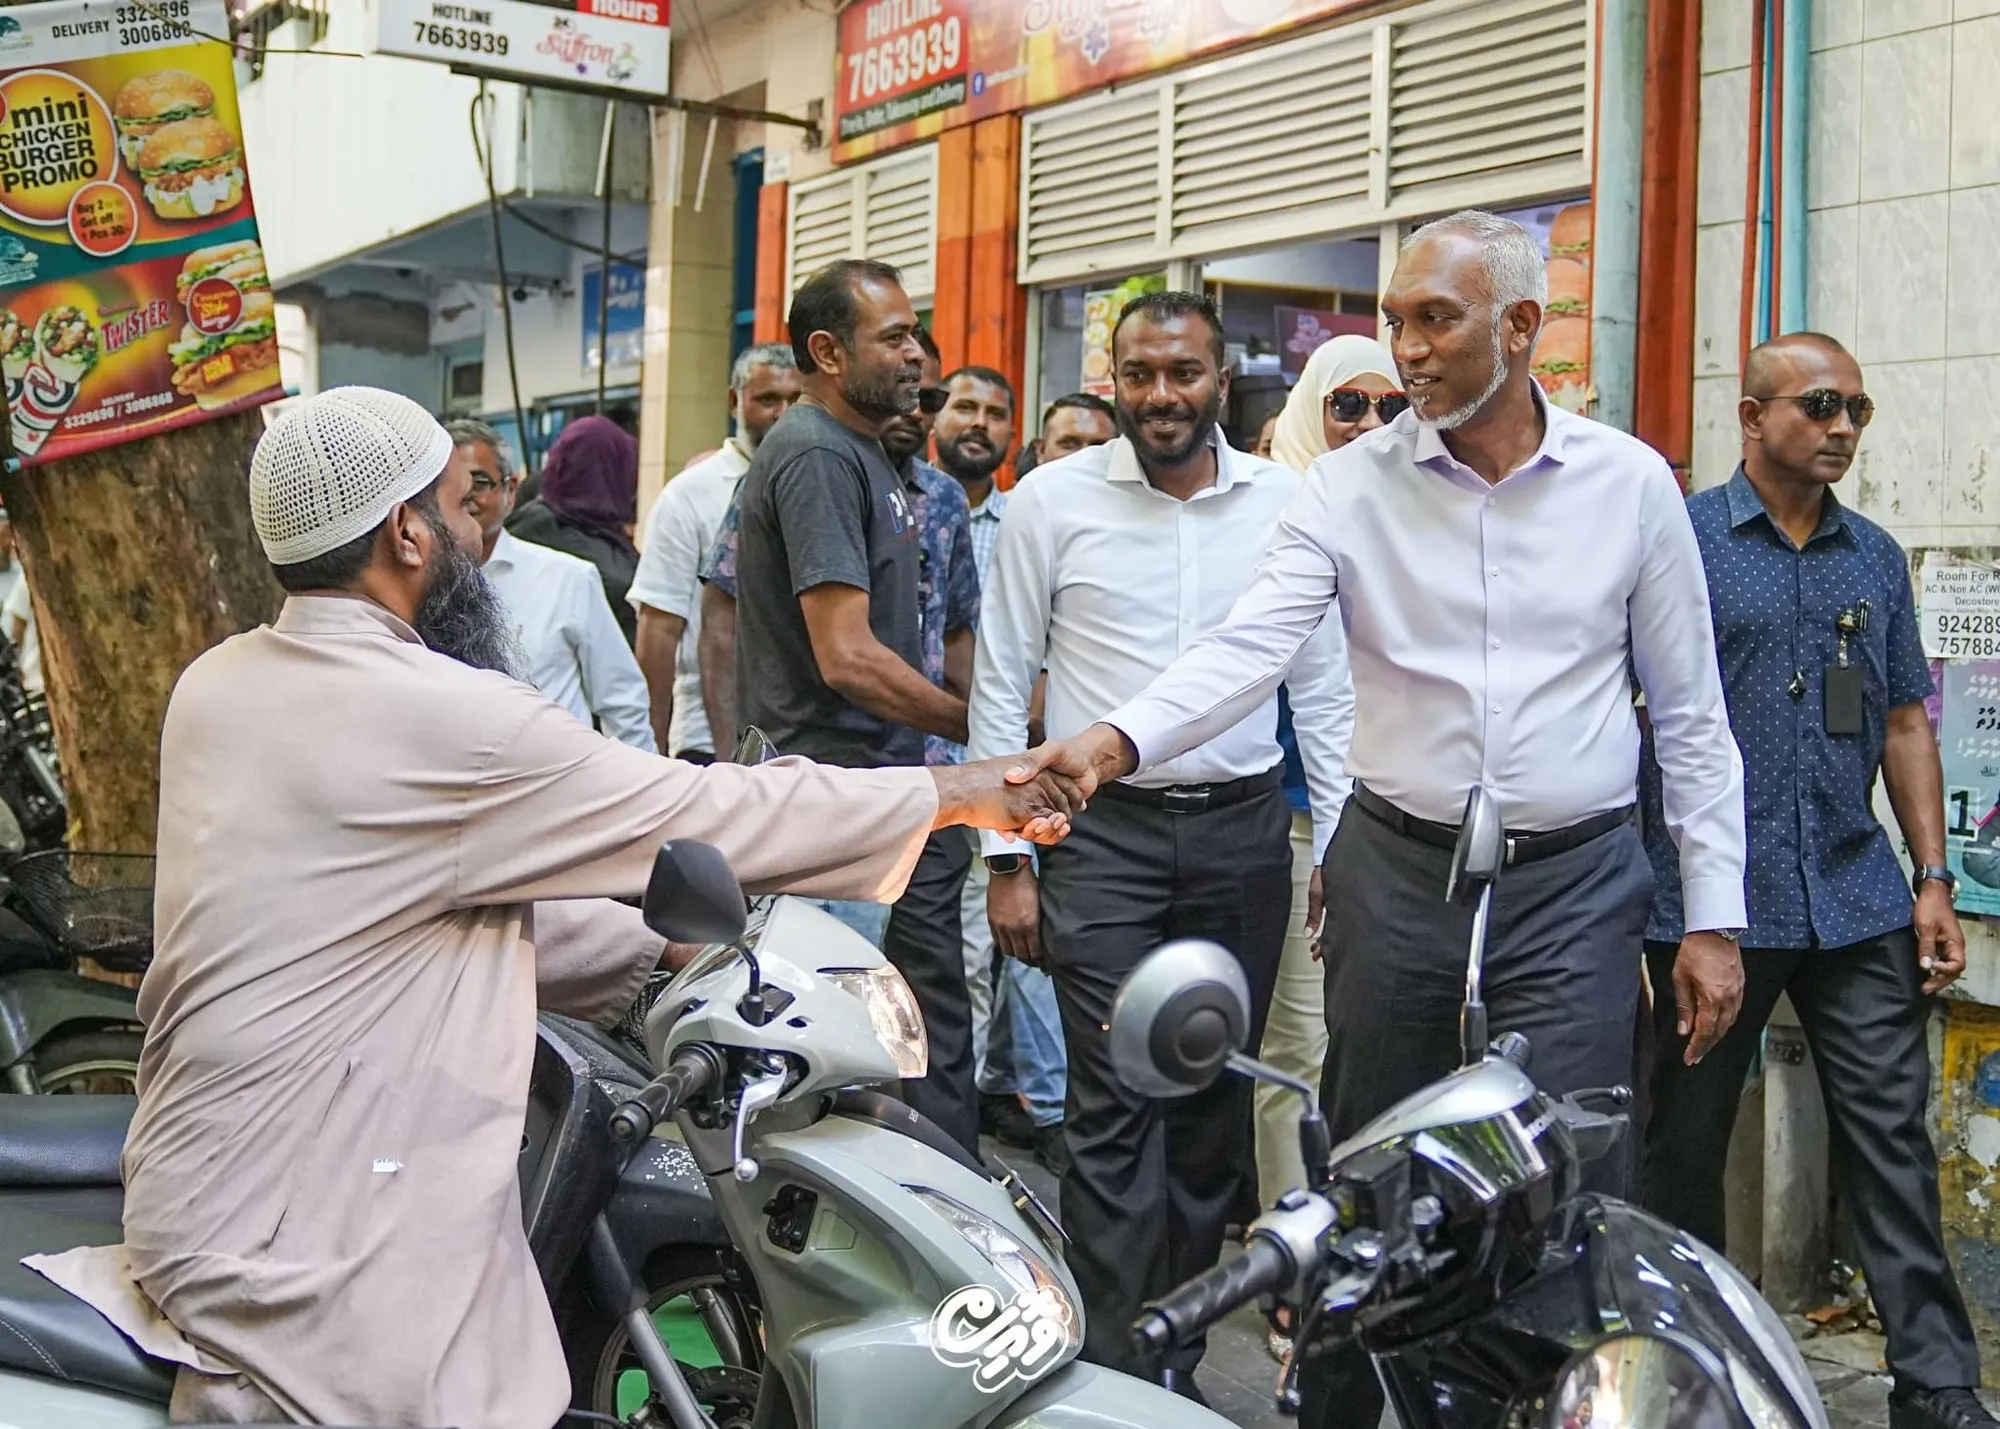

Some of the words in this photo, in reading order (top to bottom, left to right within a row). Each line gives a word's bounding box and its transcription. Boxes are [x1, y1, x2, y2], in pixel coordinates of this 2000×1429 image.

[52, 20, 110, 38] DELIVERY
[432, 3, 492, 26] HOTLINE
[413, 21, 509, 56] 7663939
[848, 15, 961, 103] 7663939
[11, 92, 90, 129] mini
[0, 120, 91, 151] CHICKEN
[0, 139, 96, 172] BURGER
[2, 159, 98, 193] PROMO
[101, 300, 170, 352] TWISTER
[1925, 585, 1938, 593] AC
[1949, 585, 1967, 593] Non
[1969, 585, 1982, 593] AC
[1936, 571, 1967, 581] Room
[1972, 571, 1989, 580] For
[1948, 790, 1975, 838] 1
